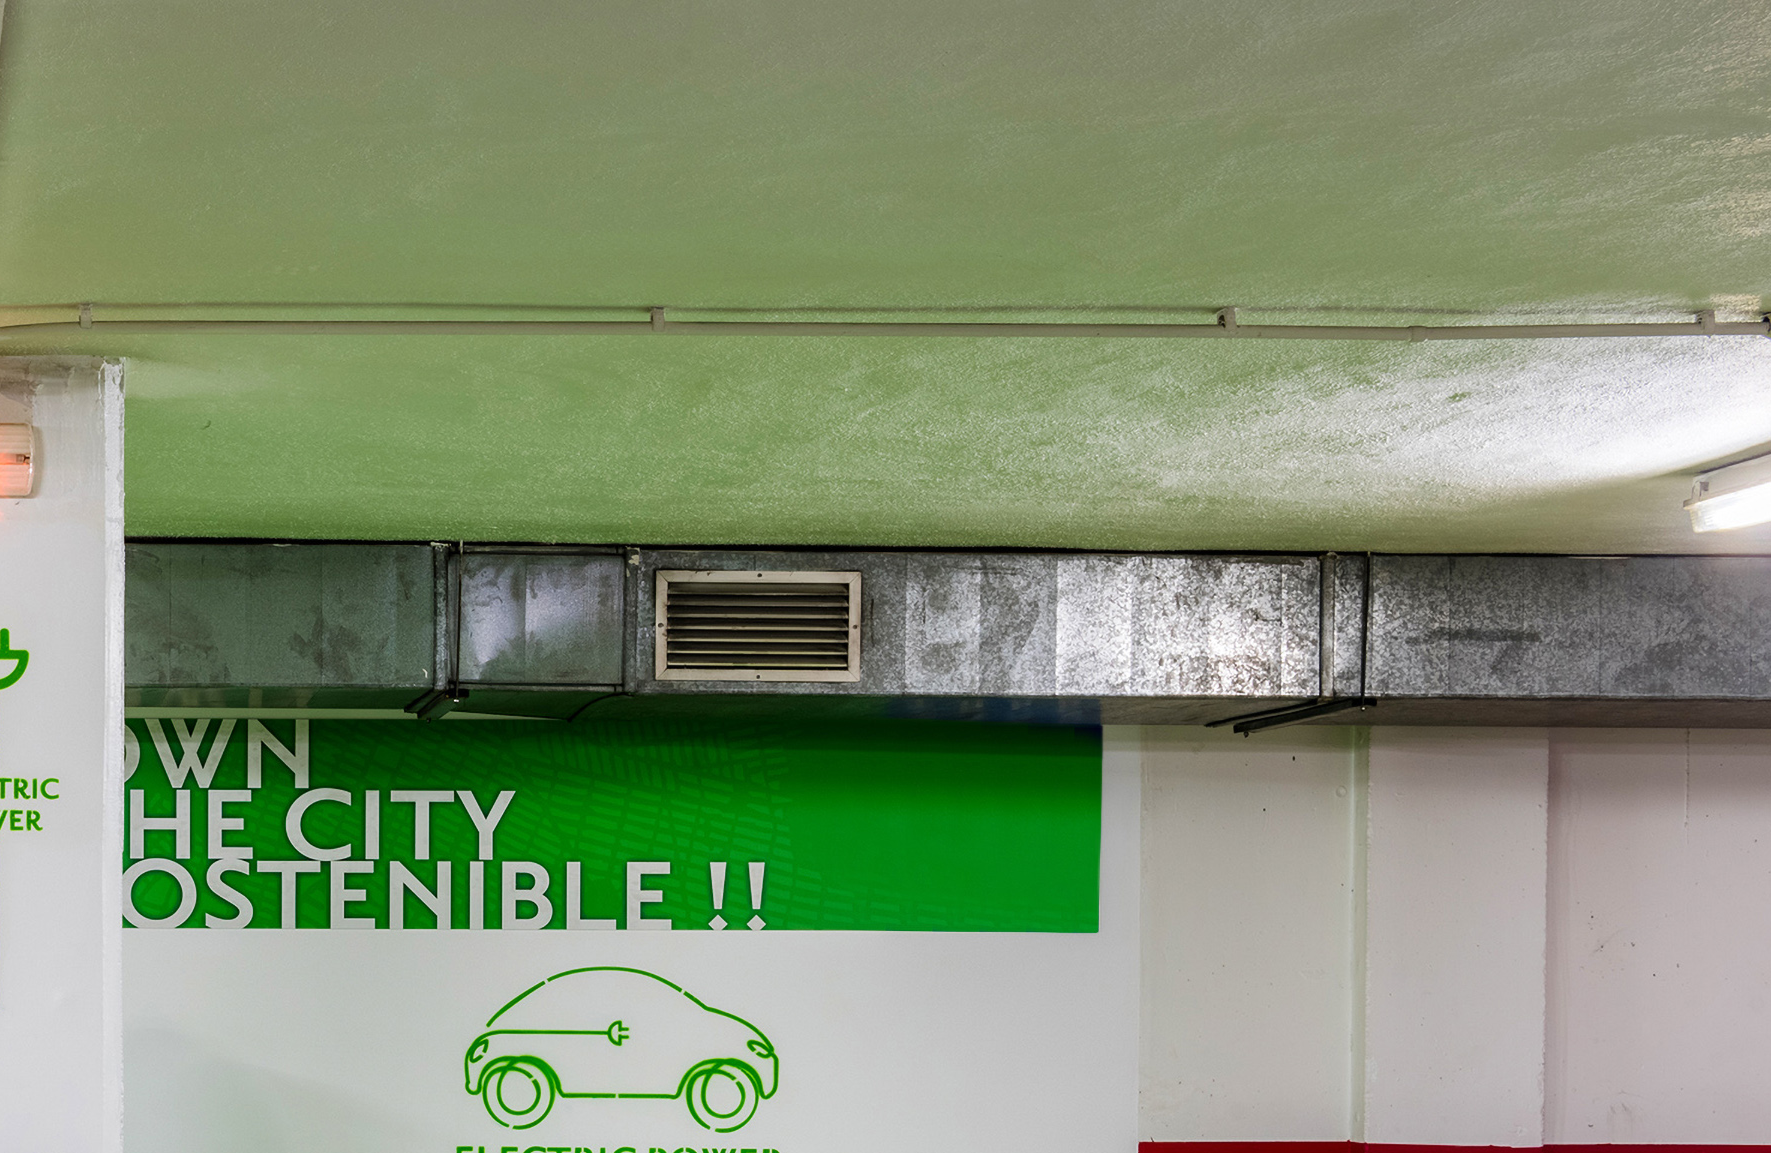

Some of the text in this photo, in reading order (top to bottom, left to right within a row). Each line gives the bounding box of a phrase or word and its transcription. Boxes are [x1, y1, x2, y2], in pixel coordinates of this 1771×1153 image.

[124, 718, 310, 788] WN
[129, 787, 517, 861] HE CITY
[123, 857, 767, 930] OSTENIBLE !!
